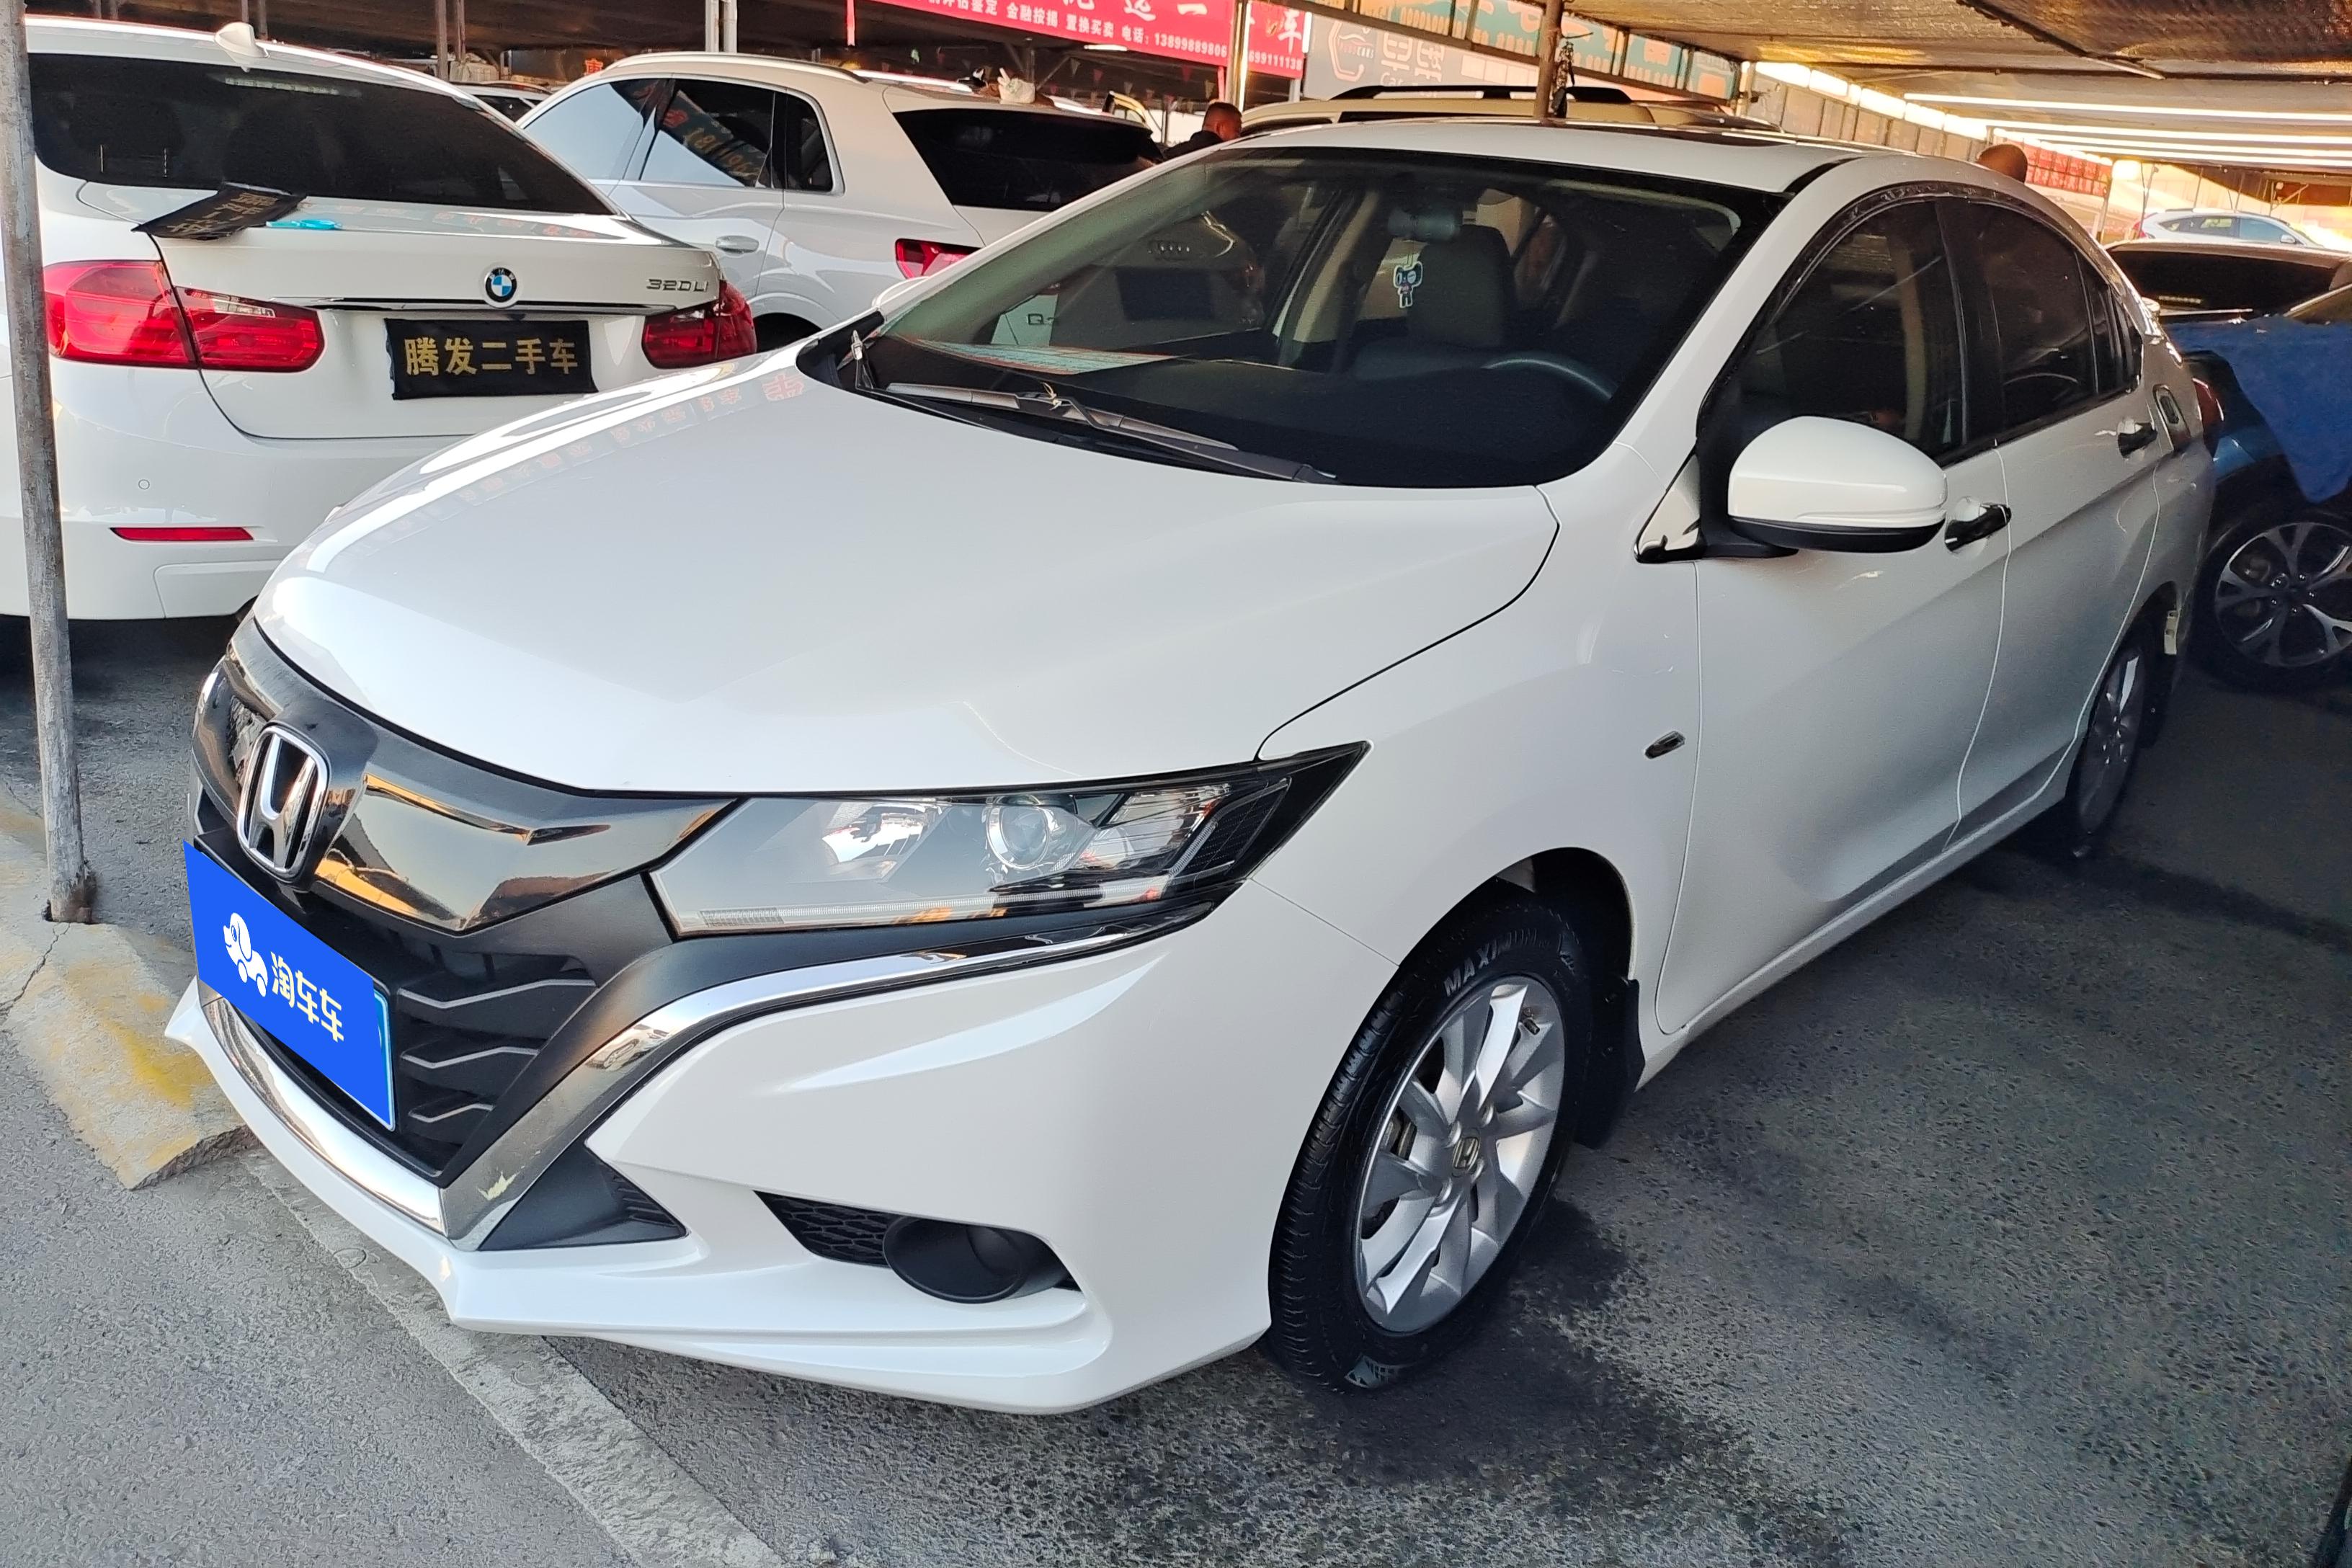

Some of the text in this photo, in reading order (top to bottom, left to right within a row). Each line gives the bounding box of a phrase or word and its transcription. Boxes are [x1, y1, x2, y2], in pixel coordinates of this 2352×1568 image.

[1007, 2, 1058, 27] 金融按揭
[1066, 14, 1114, 38] 置换买卖
[404, 337, 578, 376] 腾发二手车
